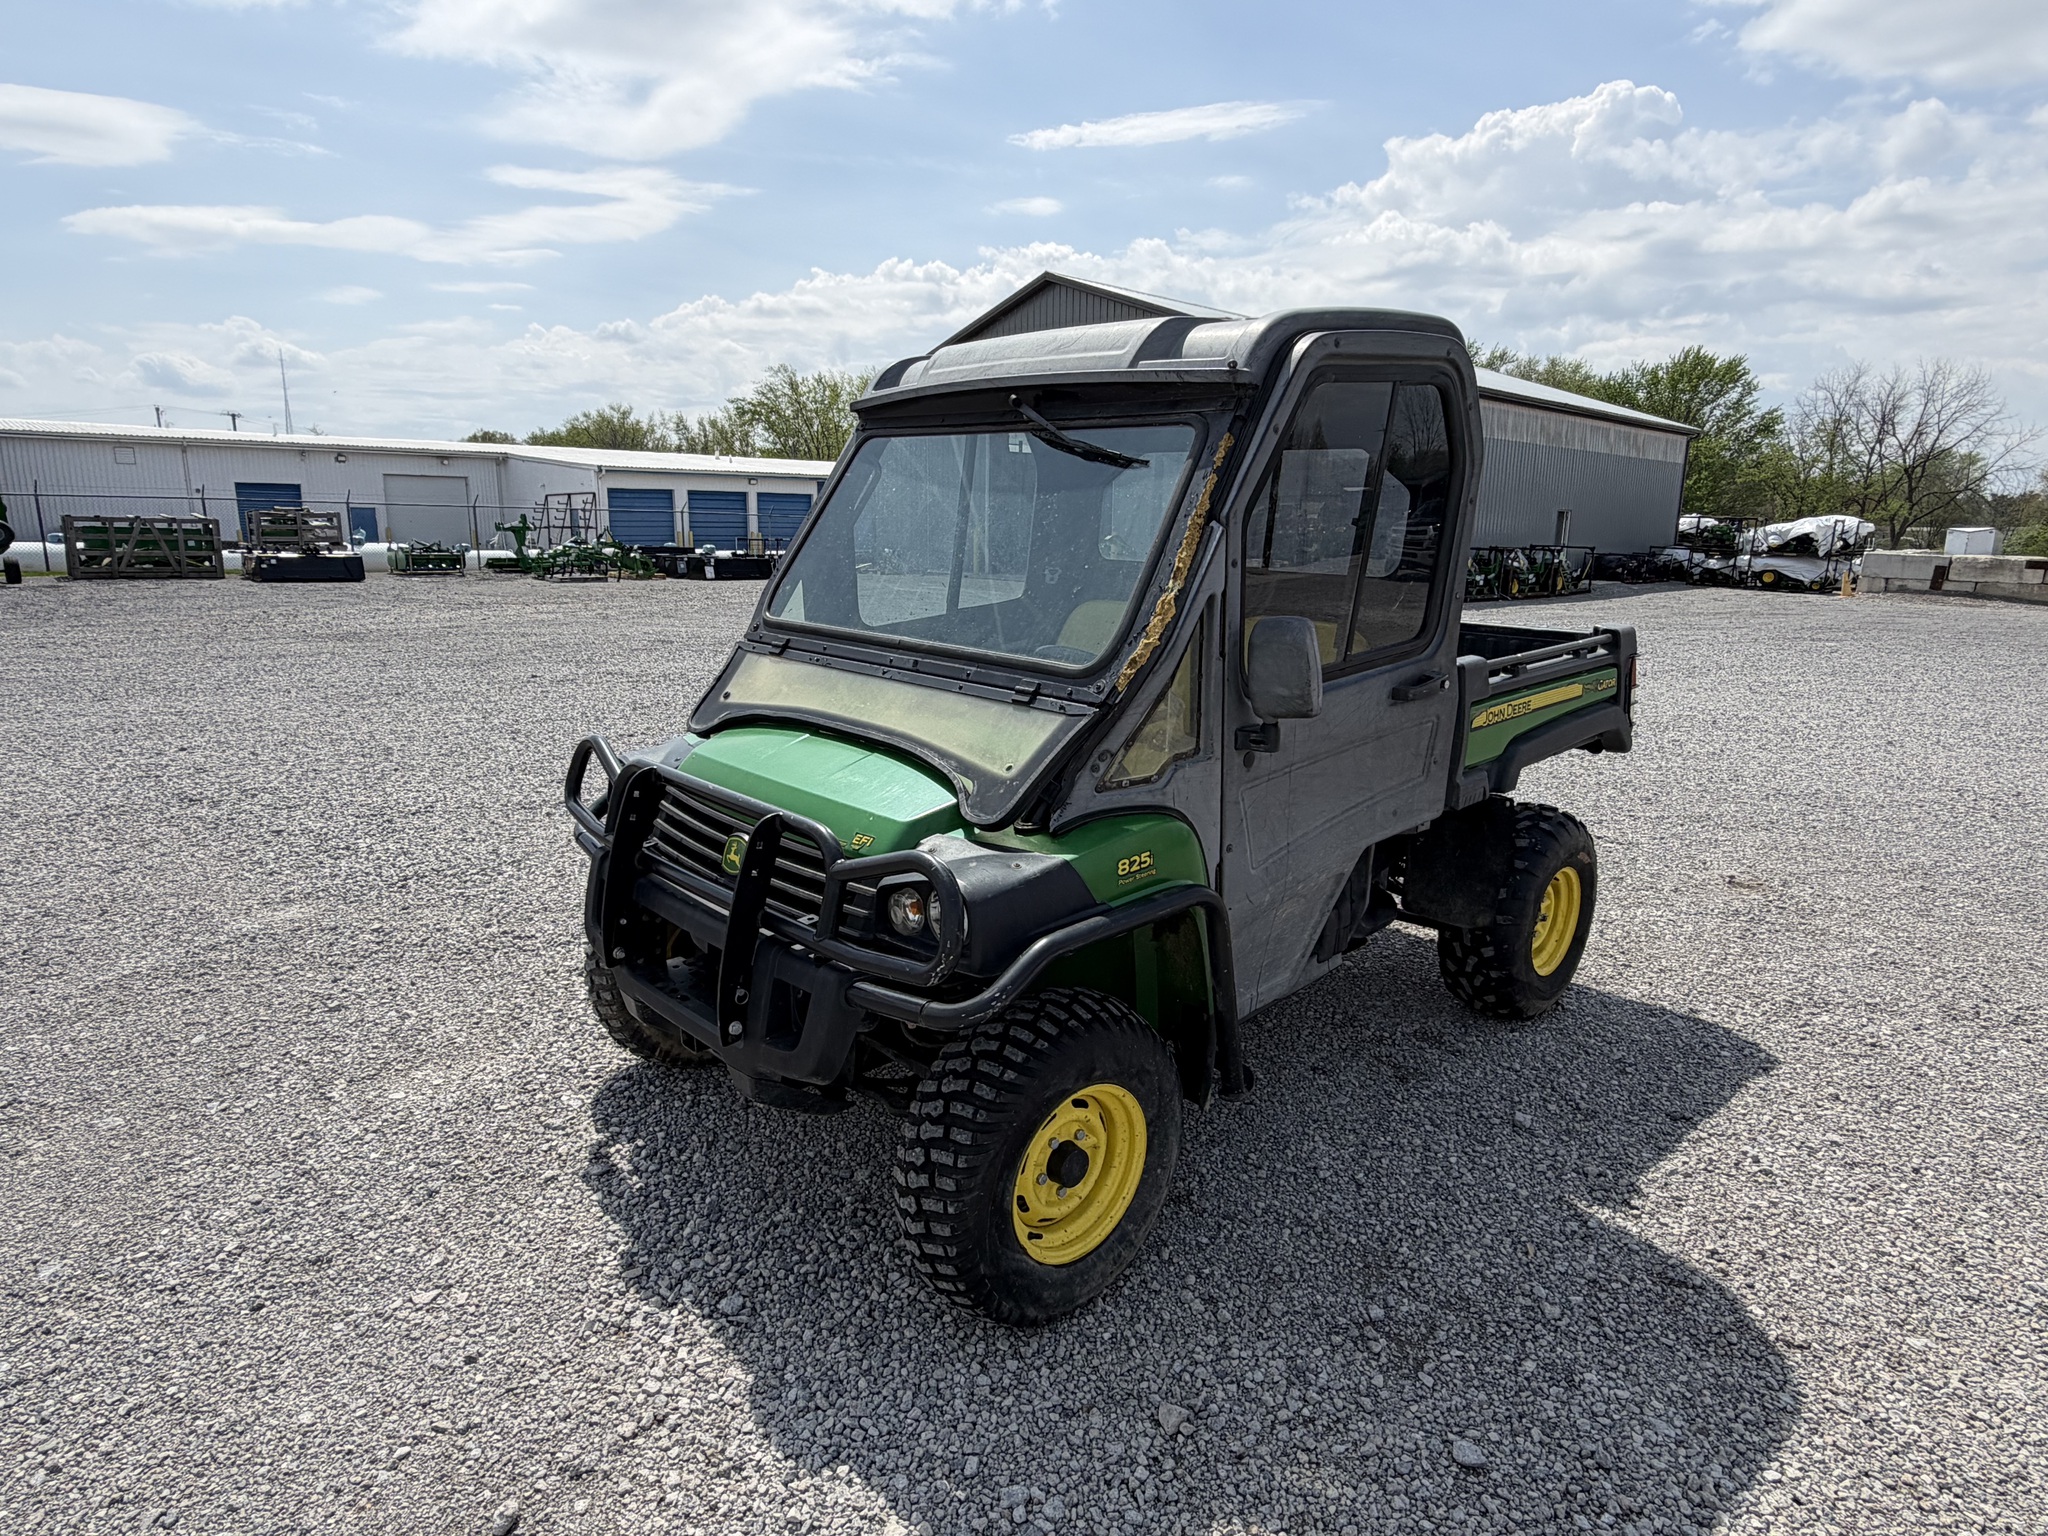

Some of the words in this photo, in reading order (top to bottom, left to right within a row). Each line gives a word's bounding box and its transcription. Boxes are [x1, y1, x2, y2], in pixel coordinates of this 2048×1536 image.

[1482, 708, 1506, 725] JOHN
[1506, 700, 1532, 717] DEERE
[852, 833, 874, 847] EFI
[1117, 851, 1154, 876] 825i
